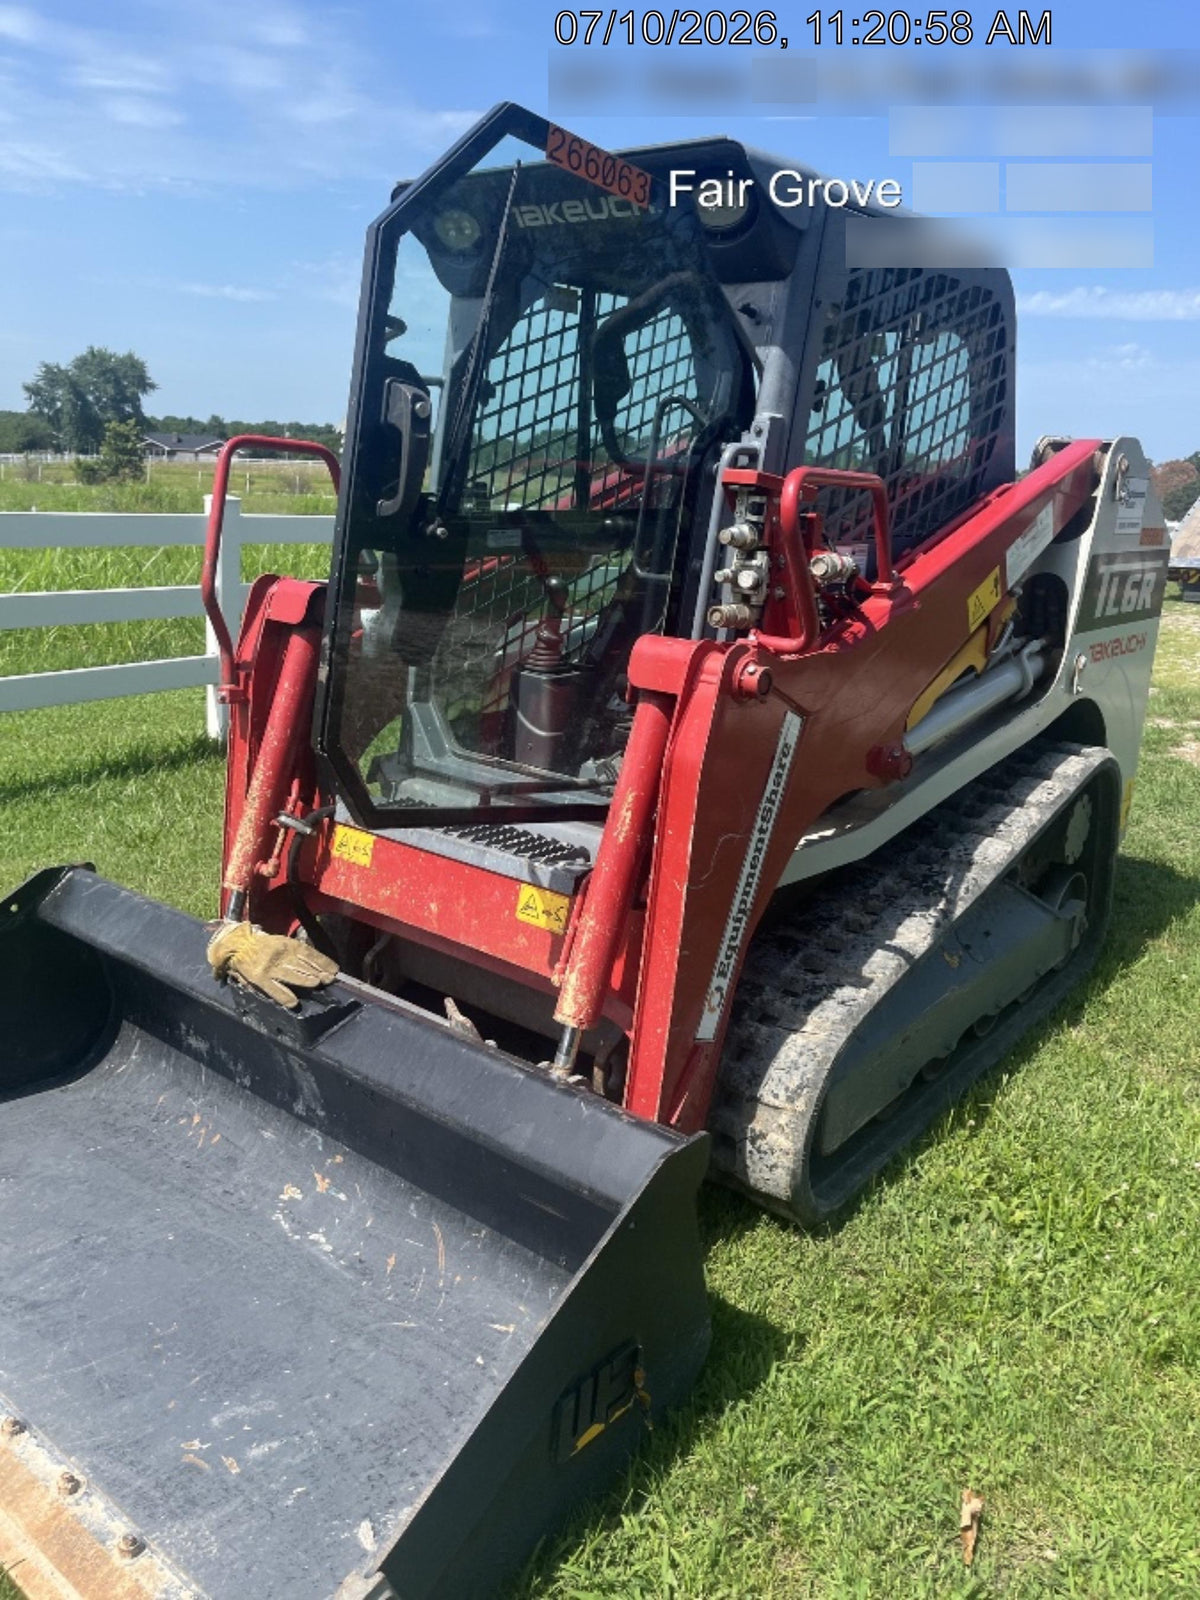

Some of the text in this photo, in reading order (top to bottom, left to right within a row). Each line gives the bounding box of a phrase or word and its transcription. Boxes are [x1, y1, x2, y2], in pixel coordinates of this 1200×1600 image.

[549, 127, 650, 204] 266063
[1095, 560, 1164, 619] TL6R
[716, 742, 792, 978] EquipmentShare
